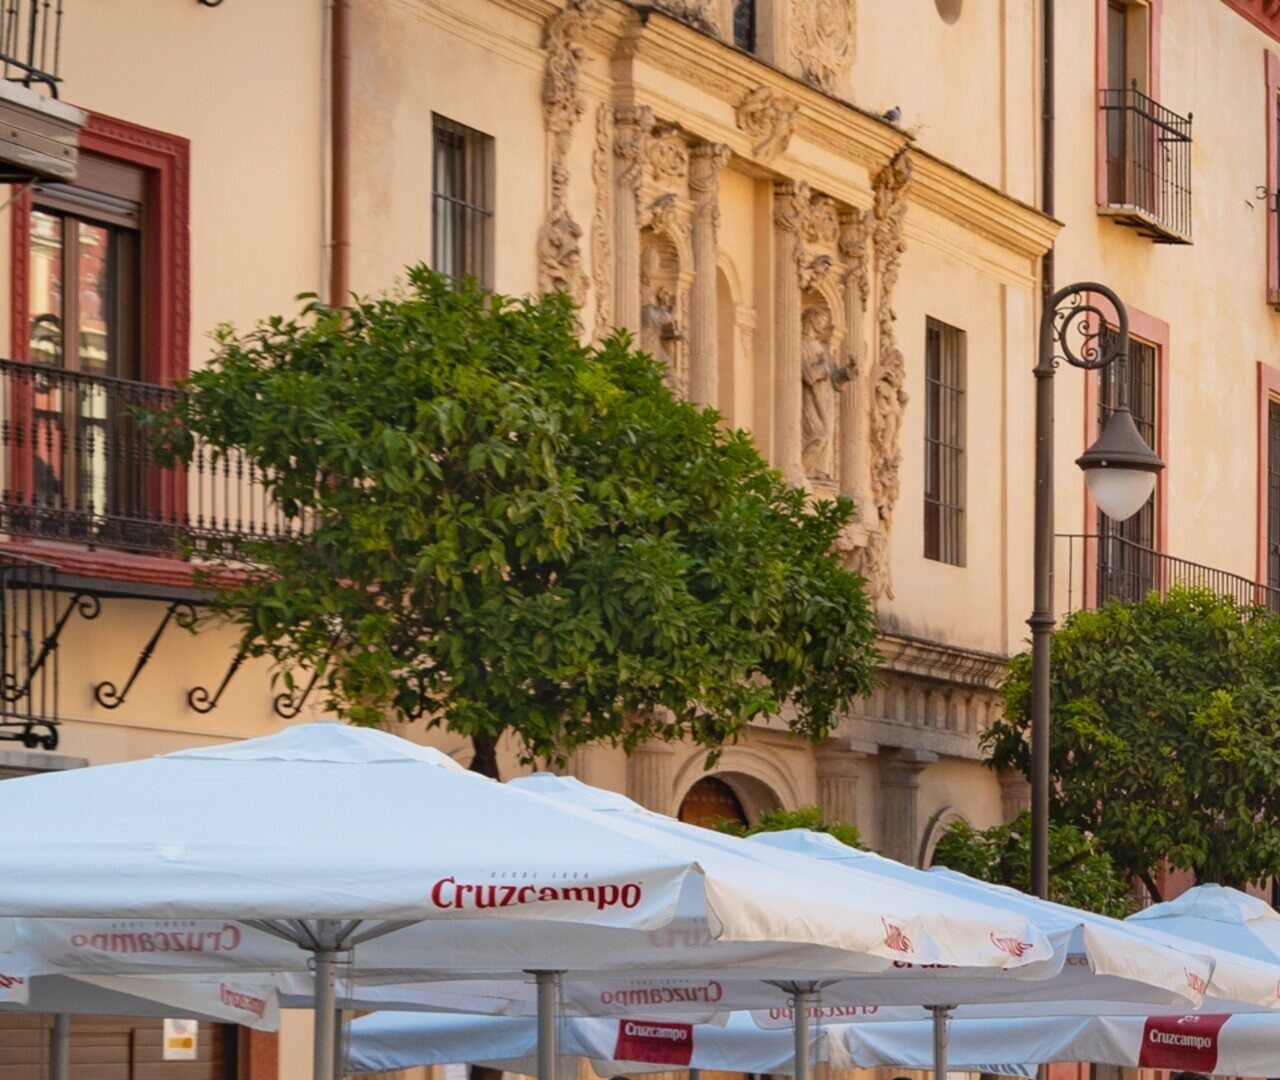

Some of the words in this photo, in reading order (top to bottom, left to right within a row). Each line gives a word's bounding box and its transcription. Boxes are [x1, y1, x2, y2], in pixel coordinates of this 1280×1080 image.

[431, 876, 642, 911] Cruzcampo
[625, 1022, 687, 1041] Cruzcampo
[1150, 1029, 1212, 1049] Cruzcampo
